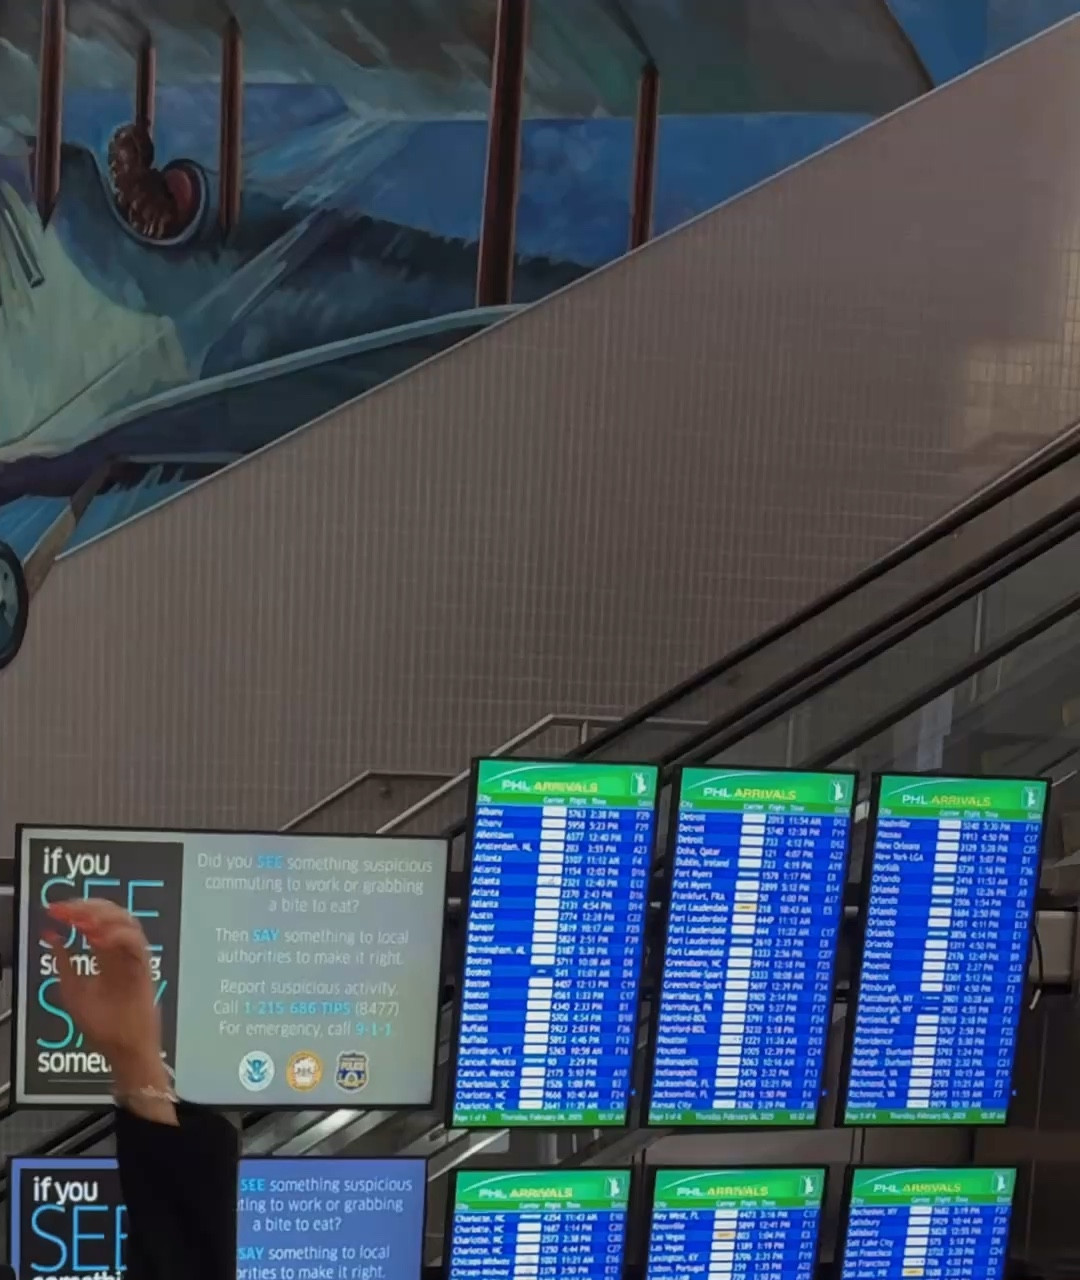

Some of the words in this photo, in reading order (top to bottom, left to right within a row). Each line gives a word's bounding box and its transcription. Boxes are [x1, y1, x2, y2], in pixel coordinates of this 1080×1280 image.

[502, 780, 530, 791] PHL
[534, 782, 598, 793] ARRIVALS
[703, 788, 730, 798] PHL
[734, 789, 796, 800] ARRIVALS
[902, 794, 928, 805] PHL
[931, 795, 990, 806] ARRIVALS
[43, 846, 63, 874] if
[66, 853, 110, 879] you
[198, 853, 221, 867] Did
[226, 856, 252, 870] you
[257, 855, 282, 869] SEE
[288, 857, 358, 874] something
[363, 859, 433, 874] suspicious
[205, 877, 282, 892] commuting
[287, 877, 300, 891] to
[306, 878, 340, 891] work
[344, 880, 360, 892] or
[362, 878, 424, 895] grabbing
[268, 900, 277, 912] a
[282, 898, 307, 912] bite
[312, 899, 326, 912] to
[330, 899, 360, 913] eat?
[216, 927, 248, 942] Then
[253, 927, 279, 941] SAY
[285, 929, 356, 946] something
[360, 931, 373, 944] to
[378, 930, 409, 944] local
[217, 950, 291, 964] authorities
[296, 951, 310, 964] to
[314, 950, 350, 964] make
[356, 952, 364, 964] it
[220, 980, 265, 995] Report
[271, 981, 340, 996] suspicious
[213, 1001, 239, 1014] Call
[220, 1021, 240, 1034] For
[328, 1022, 351, 1035] call
[34, 1176, 52, 1201] if
[54, 1181, 98, 1205] you
[241, 1178, 265, 1191] SEE
[270, 1178, 340, 1193] something
[344, 1178, 412, 1193] suspicious
[676, 1187, 705, 1197] PHL
[707, 1187, 768, 1197] ARRIVALS
[874, 1184, 901, 1193] PHL
[903, 1183, 961, 1194] ARRIVALS
[479, 1189, 507, 1199] PHL
[509, 1188, 573, 1199] ARRIVALS
[271, 1200, 283, 1211] to
[288, 1199, 322, 1211] work
[326, 1200, 340, 1211] or
[344, 1199, 403, 1212] grabbing
[252, 1220, 261, 1232] a
[266, 1218, 292, 1232] bite
[296, 1218, 309, 1231] to
[313, 1218, 342, 1231] eat?
[238, 1247, 264, 1260] SAY
[269, 1246, 338, 1261] something
[342, 1247, 355, 1259] to
[360, 1246, 390, 1259] local
[237, 1266, 276, 1280] orities
[281, 1266, 294, 1280] to
[298, 1266, 334, 1280] make
[339, 1265, 348, 1280] it
[352, 1265, 386, 1280] right.
